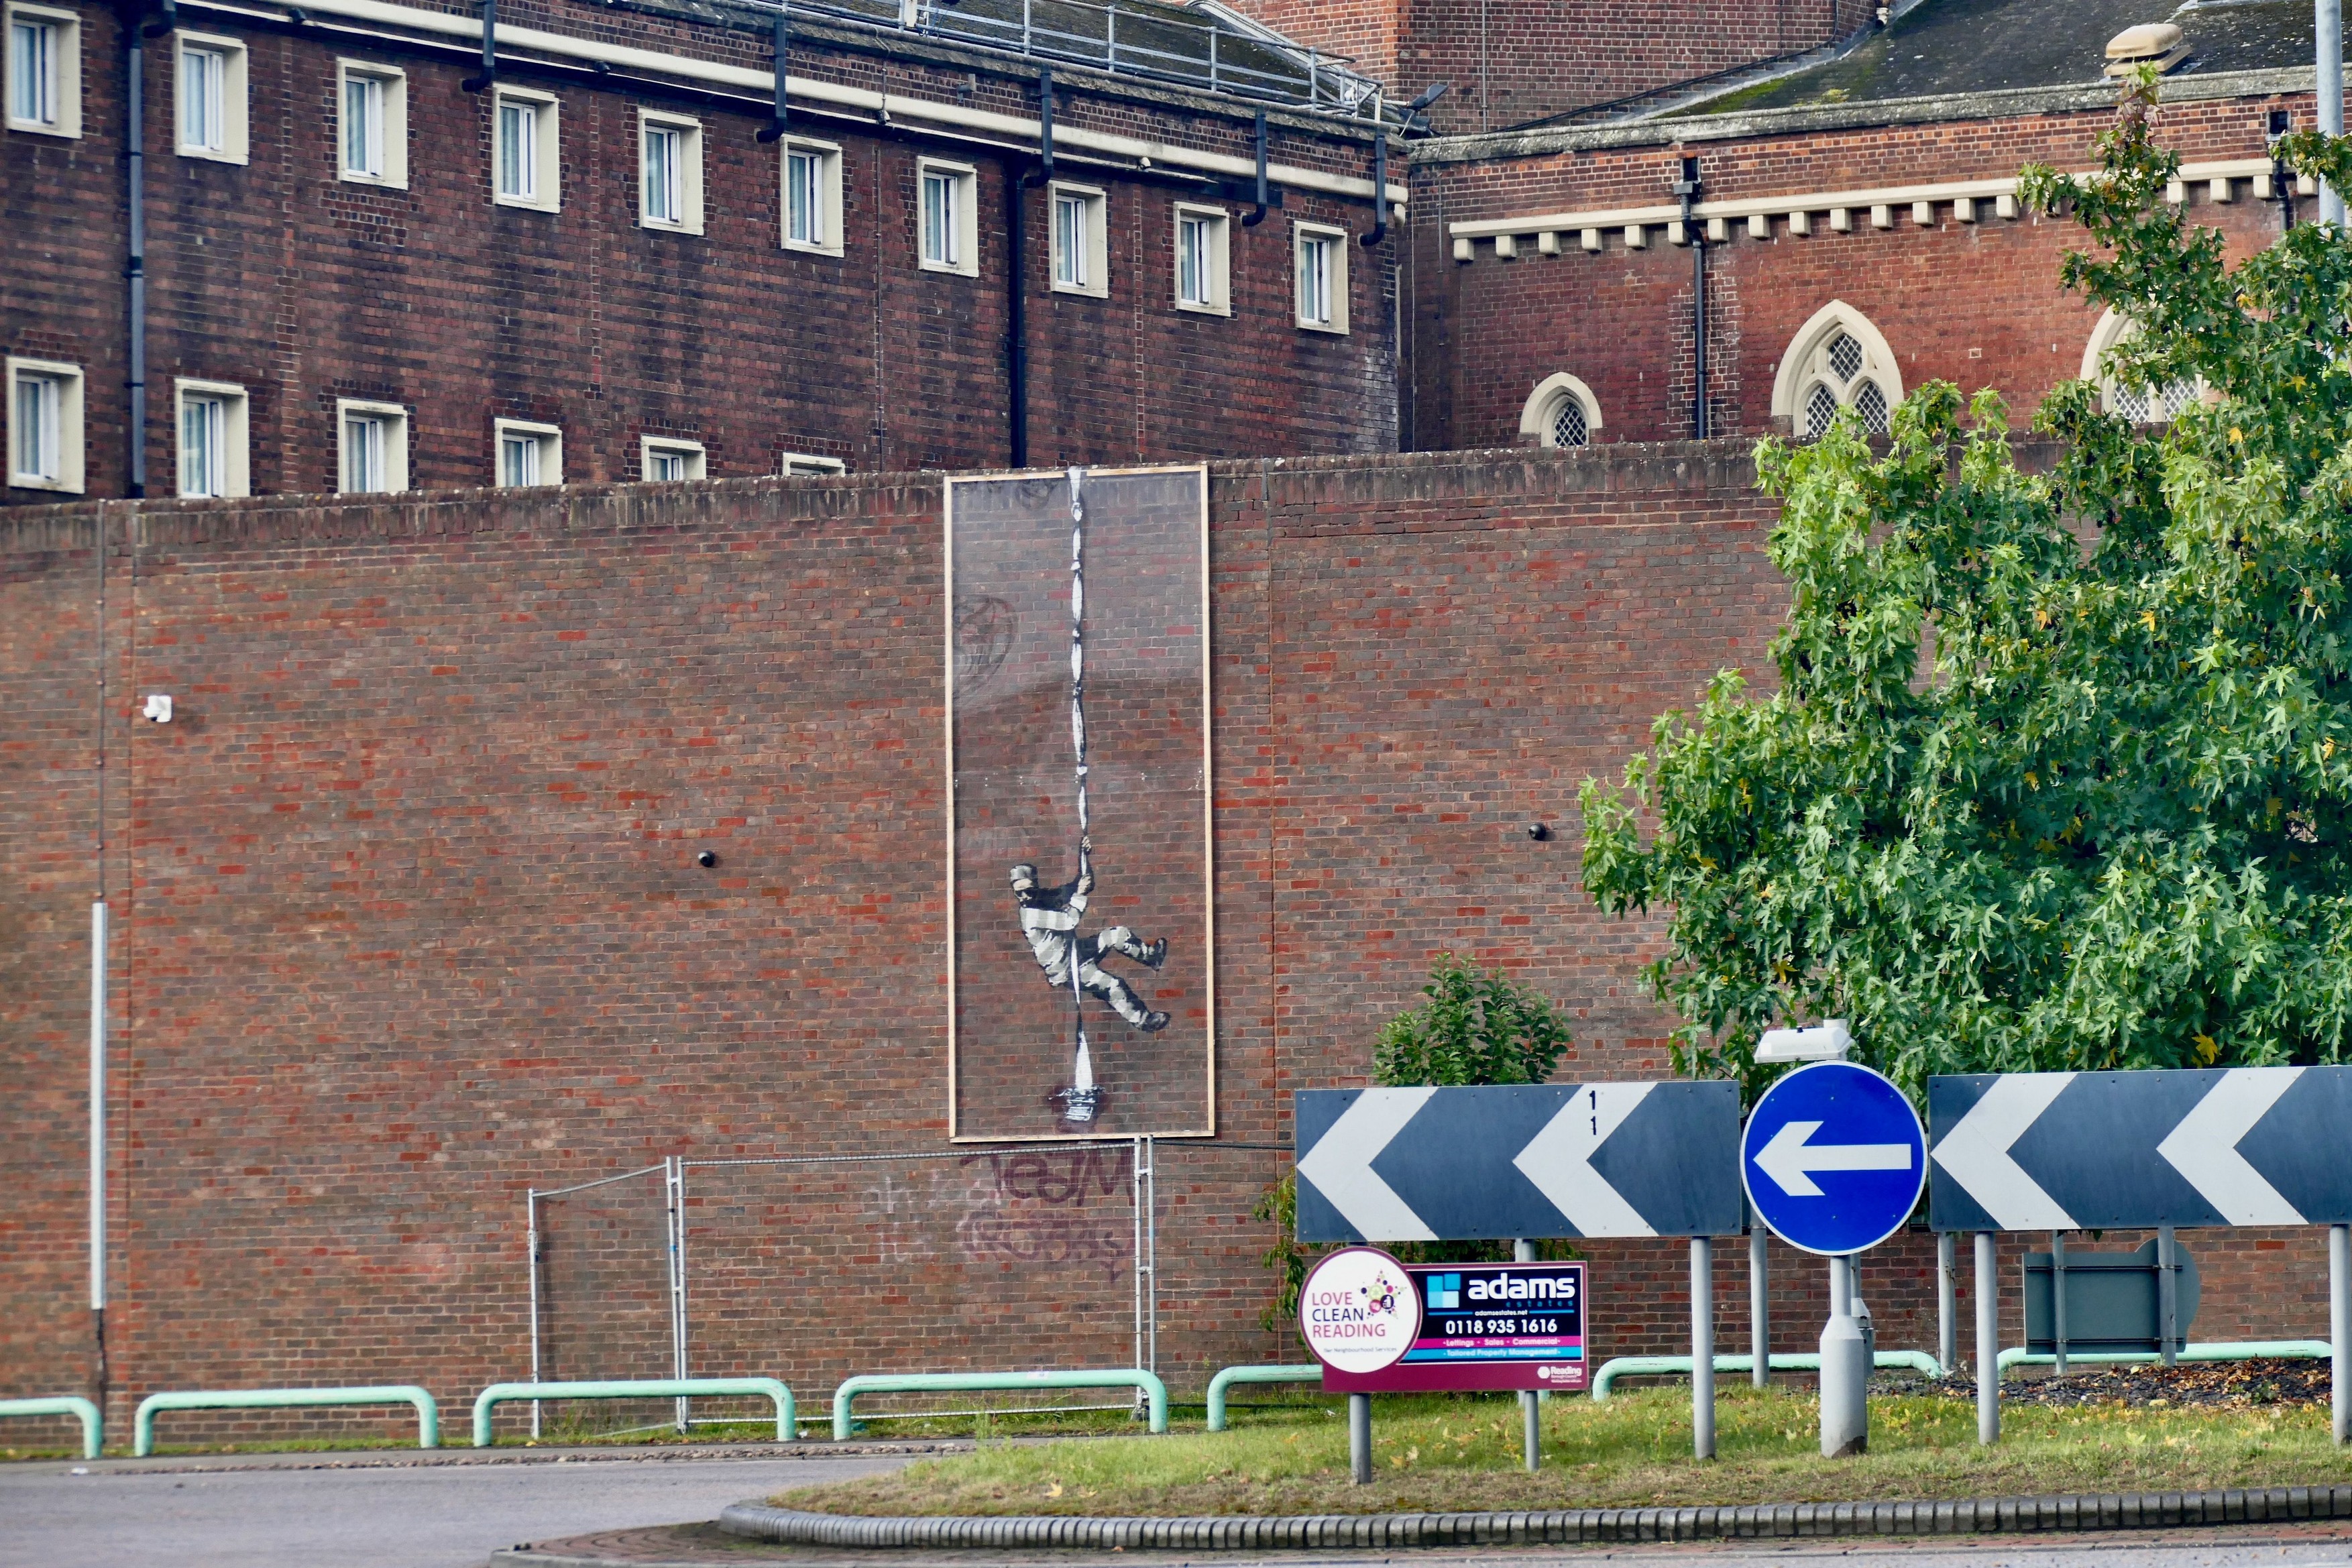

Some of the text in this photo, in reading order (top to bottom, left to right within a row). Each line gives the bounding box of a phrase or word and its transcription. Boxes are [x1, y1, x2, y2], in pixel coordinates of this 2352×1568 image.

[1468, 1272, 1575, 1300] adams
[1312, 1292, 1353, 1306] LOVE
[1506, 1300, 1573, 1308] estates
[1312, 1308, 1364, 1322] CLEAN
[1312, 1323, 1386, 1338] READING
[1445, 1319, 1557, 1335] 0118 935 1616
[1446, 1339, 1474, 1347] Lettings
[1508, 1349, 1558, 1357] Management
[1551, 1365, 1582, 1376] Reading
